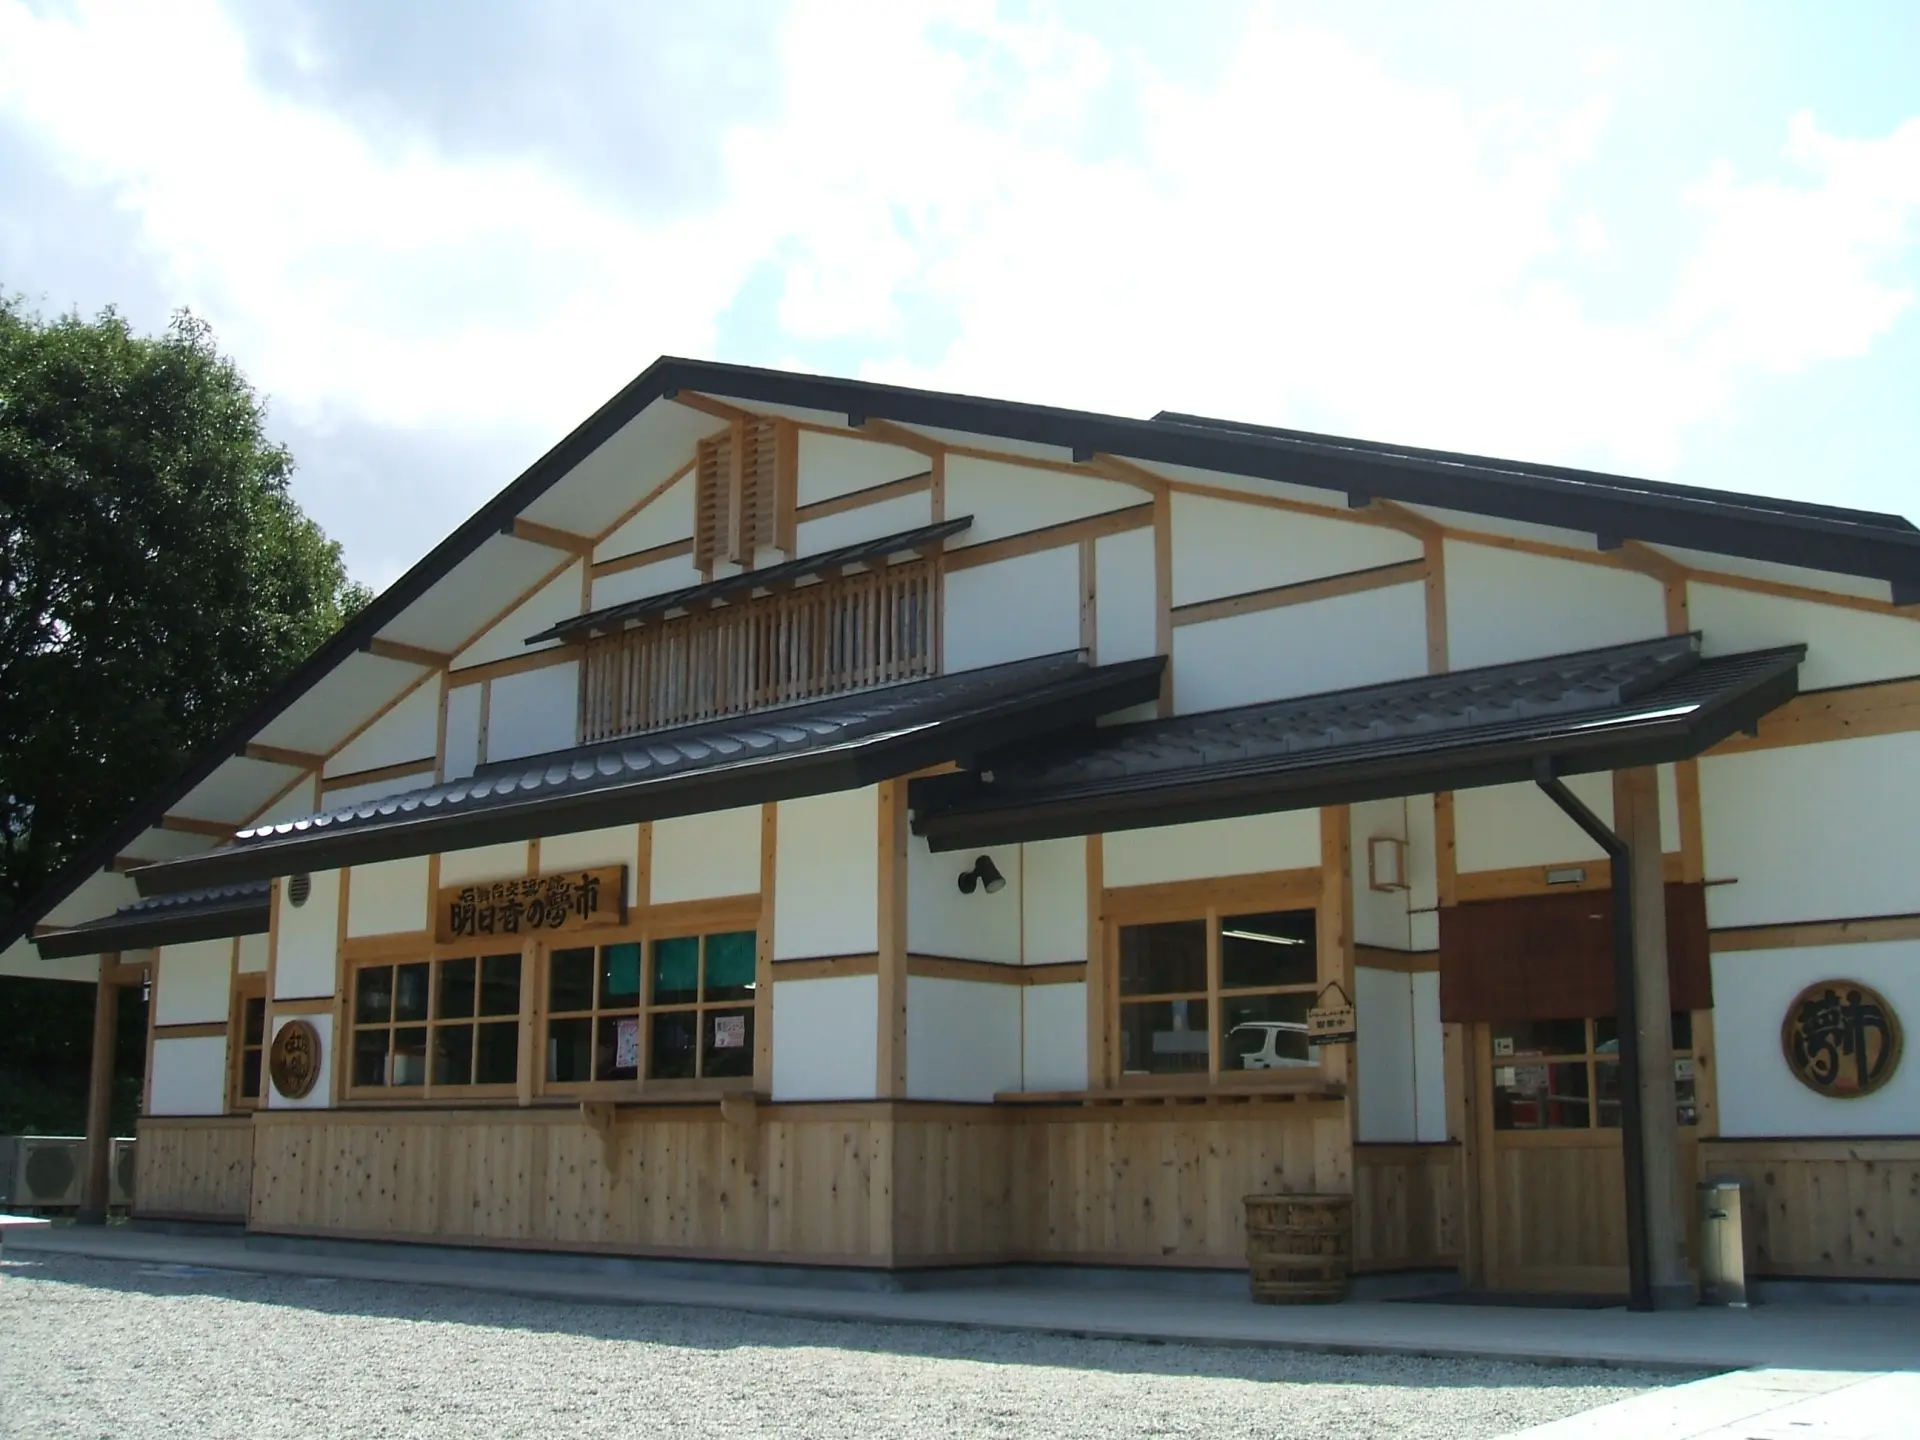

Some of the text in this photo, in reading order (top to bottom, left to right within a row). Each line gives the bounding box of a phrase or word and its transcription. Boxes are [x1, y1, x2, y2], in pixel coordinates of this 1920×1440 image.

[450, 873, 600, 936] 明日香の夢市
